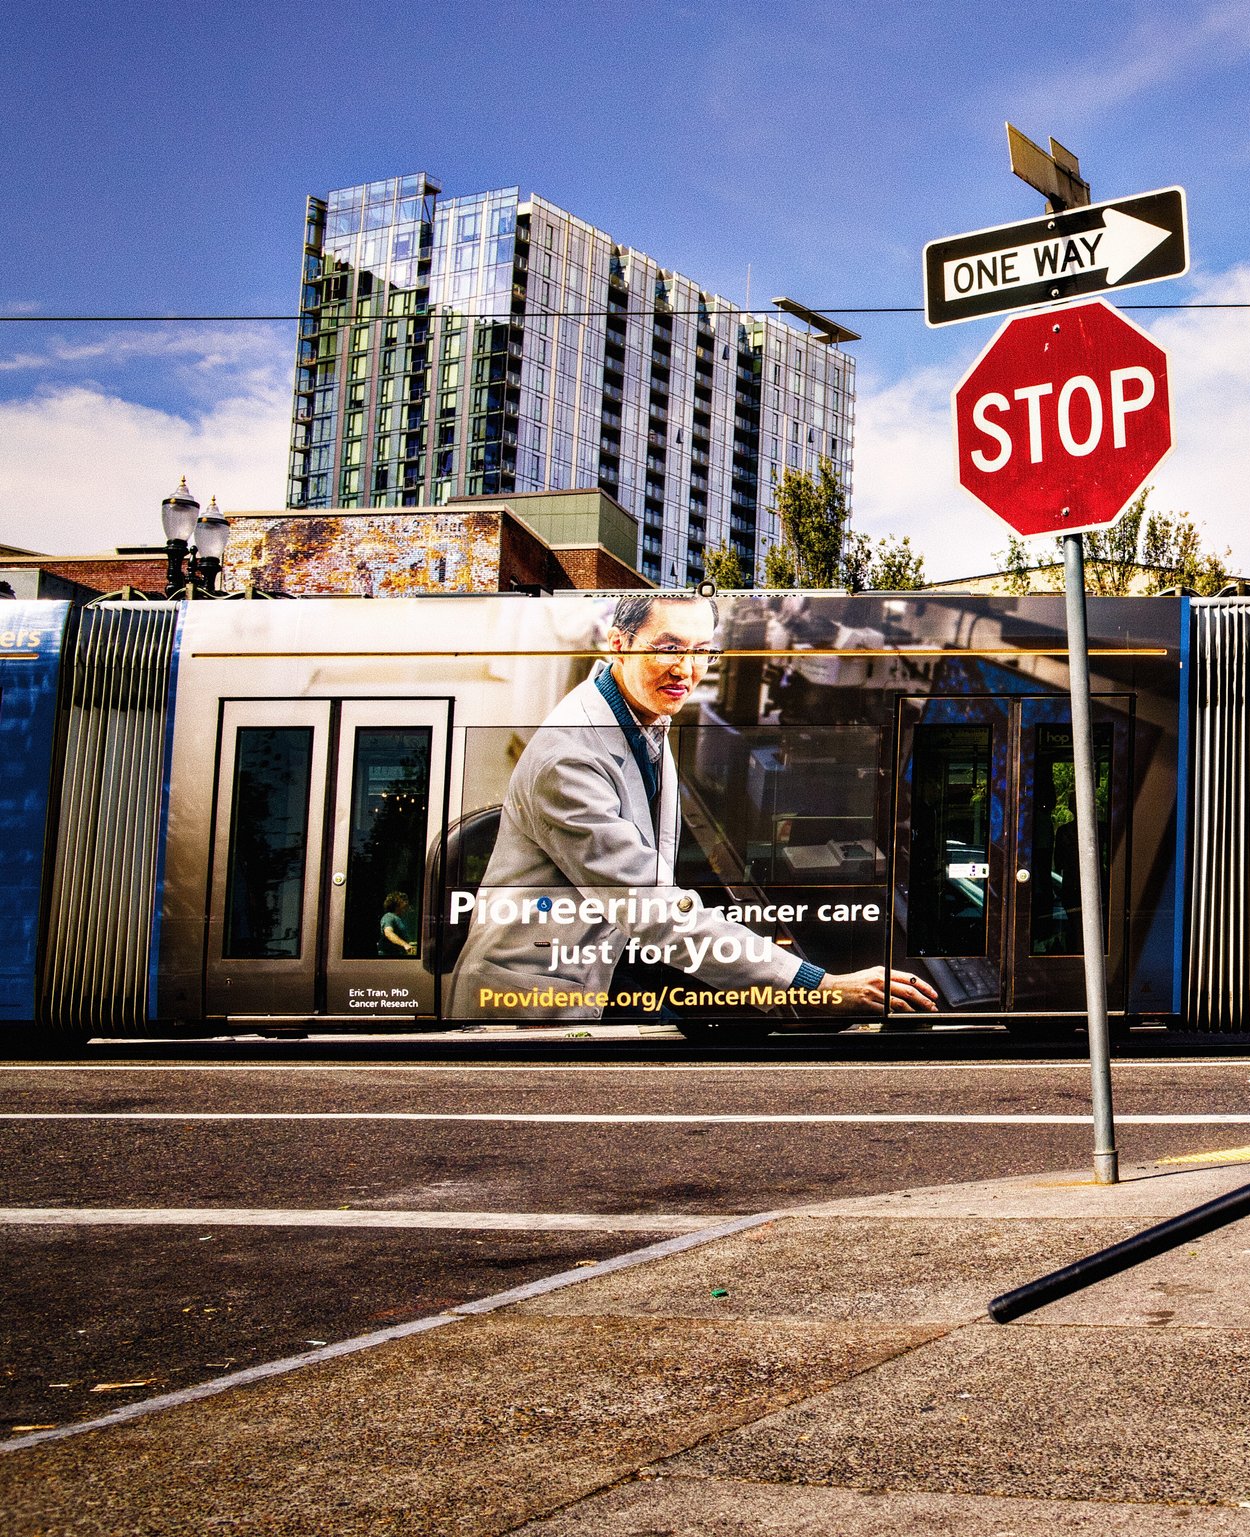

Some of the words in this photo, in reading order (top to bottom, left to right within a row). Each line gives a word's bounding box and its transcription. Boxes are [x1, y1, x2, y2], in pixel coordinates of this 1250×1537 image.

[953, 252, 1020, 294] ONE
[1033, 233, 1104, 277] WAY
[971, 366, 1156, 473] STOP
[450, 889, 697, 933] Pioneering
[711, 903, 809, 923] cancer
[817, 903, 881, 922] care
[548, 937, 613, 972] just
[625, 937, 678, 964] for
[683, 935, 774, 974] you
[349, 988, 365, 997] Eric
[366, 988, 389, 998] Tran,
[391, 988, 409, 997] PhD
[349, 999, 379, 1008] Cancer
[380, 999, 419, 1008] Research
[479, 986, 843, 1012] Providence.org/CancerMatters
